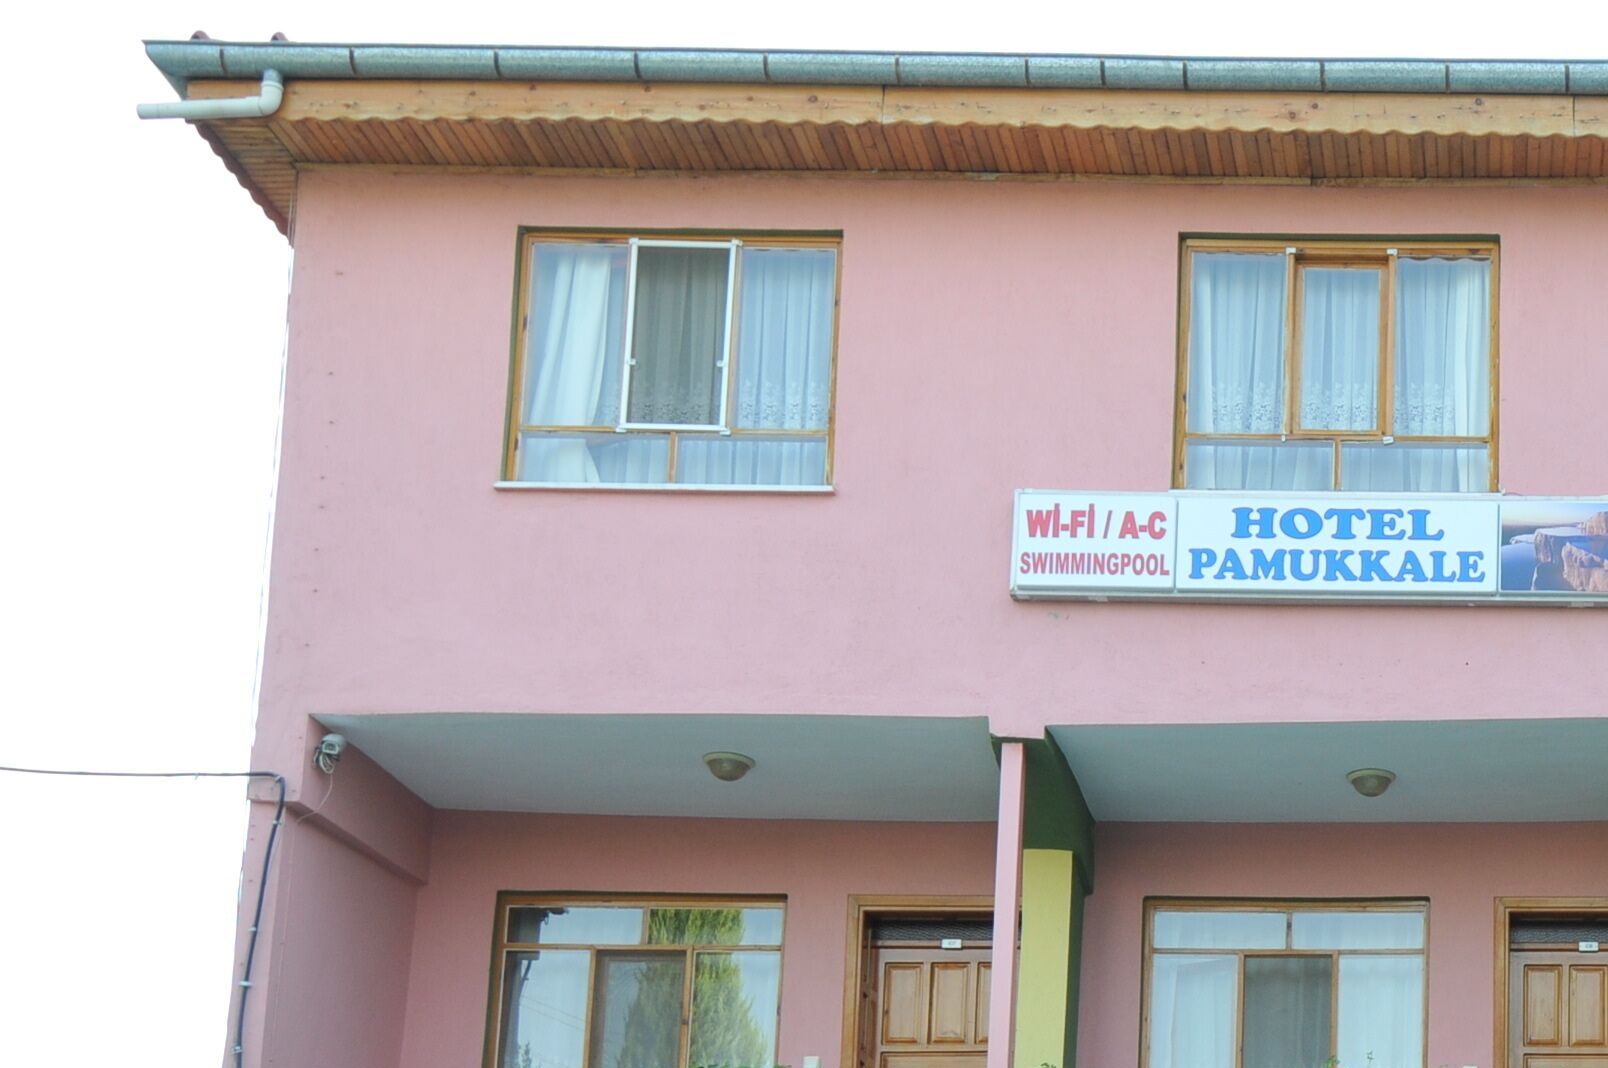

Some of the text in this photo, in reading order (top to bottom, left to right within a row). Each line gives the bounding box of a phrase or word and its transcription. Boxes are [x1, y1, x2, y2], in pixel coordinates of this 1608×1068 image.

[1118, 511, 1168, 540] A-C
[1231, 507, 1445, 541] HOTEL
[1020, 551, 1170, 576] SWIMMINGPOOL
[1188, 548, 1486, 583] PAMUKKALE
